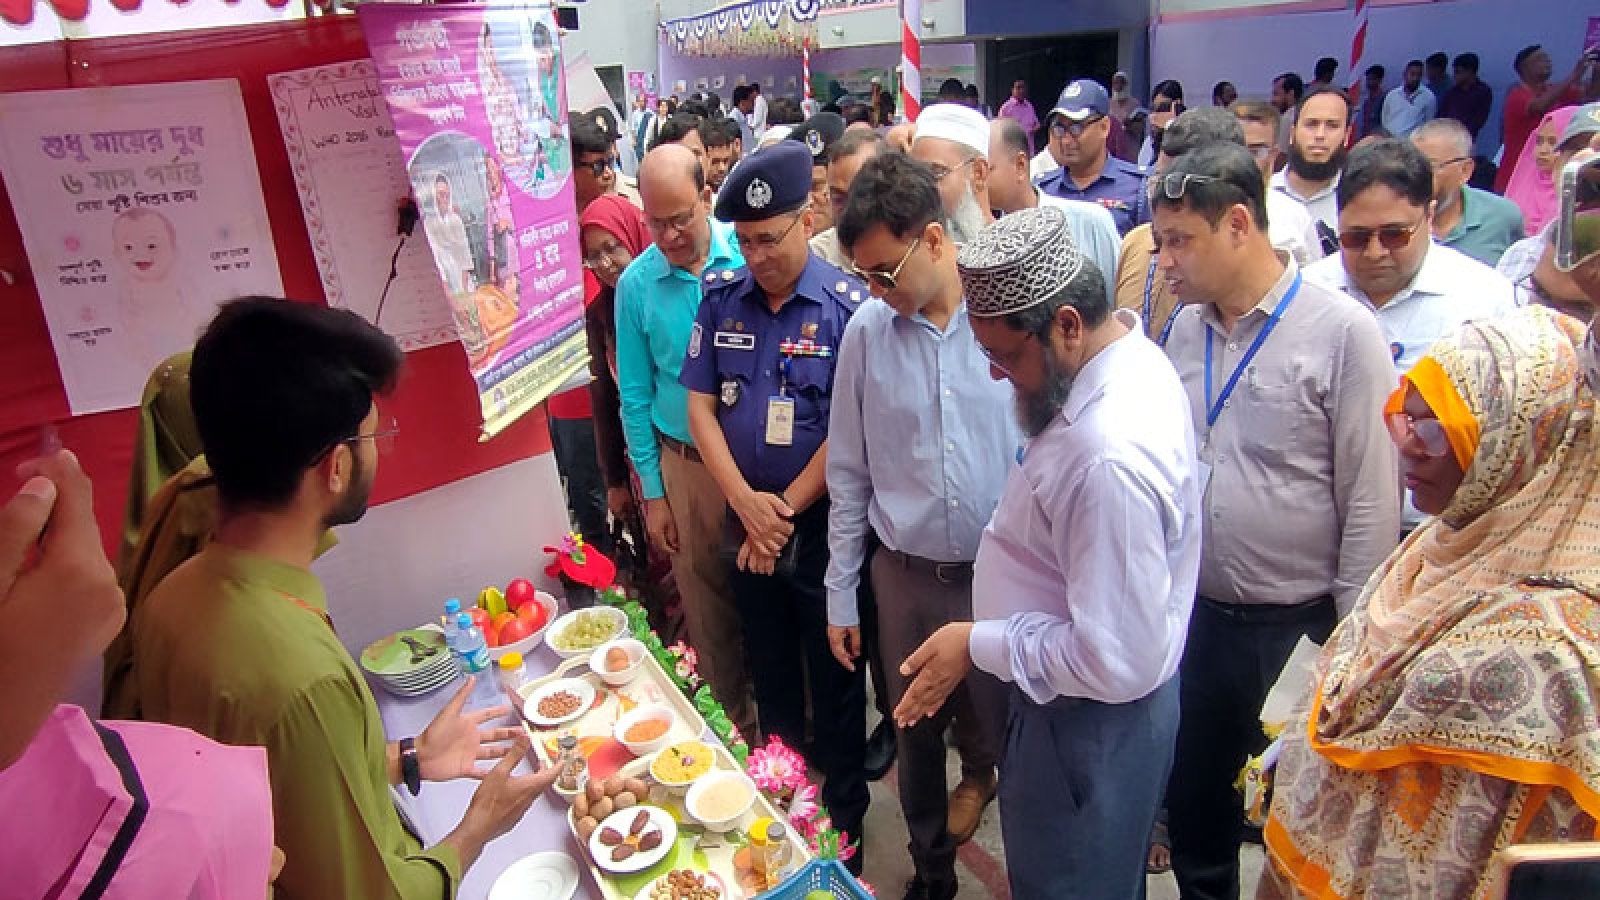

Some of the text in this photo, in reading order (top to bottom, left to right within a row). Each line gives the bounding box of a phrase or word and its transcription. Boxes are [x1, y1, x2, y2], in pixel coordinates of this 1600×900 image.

[41, 126, 204, 163] শুধু মায়ের দুধ
[61, 174, 84, 194] ৬
[88, 168, 137, 190] মাস
